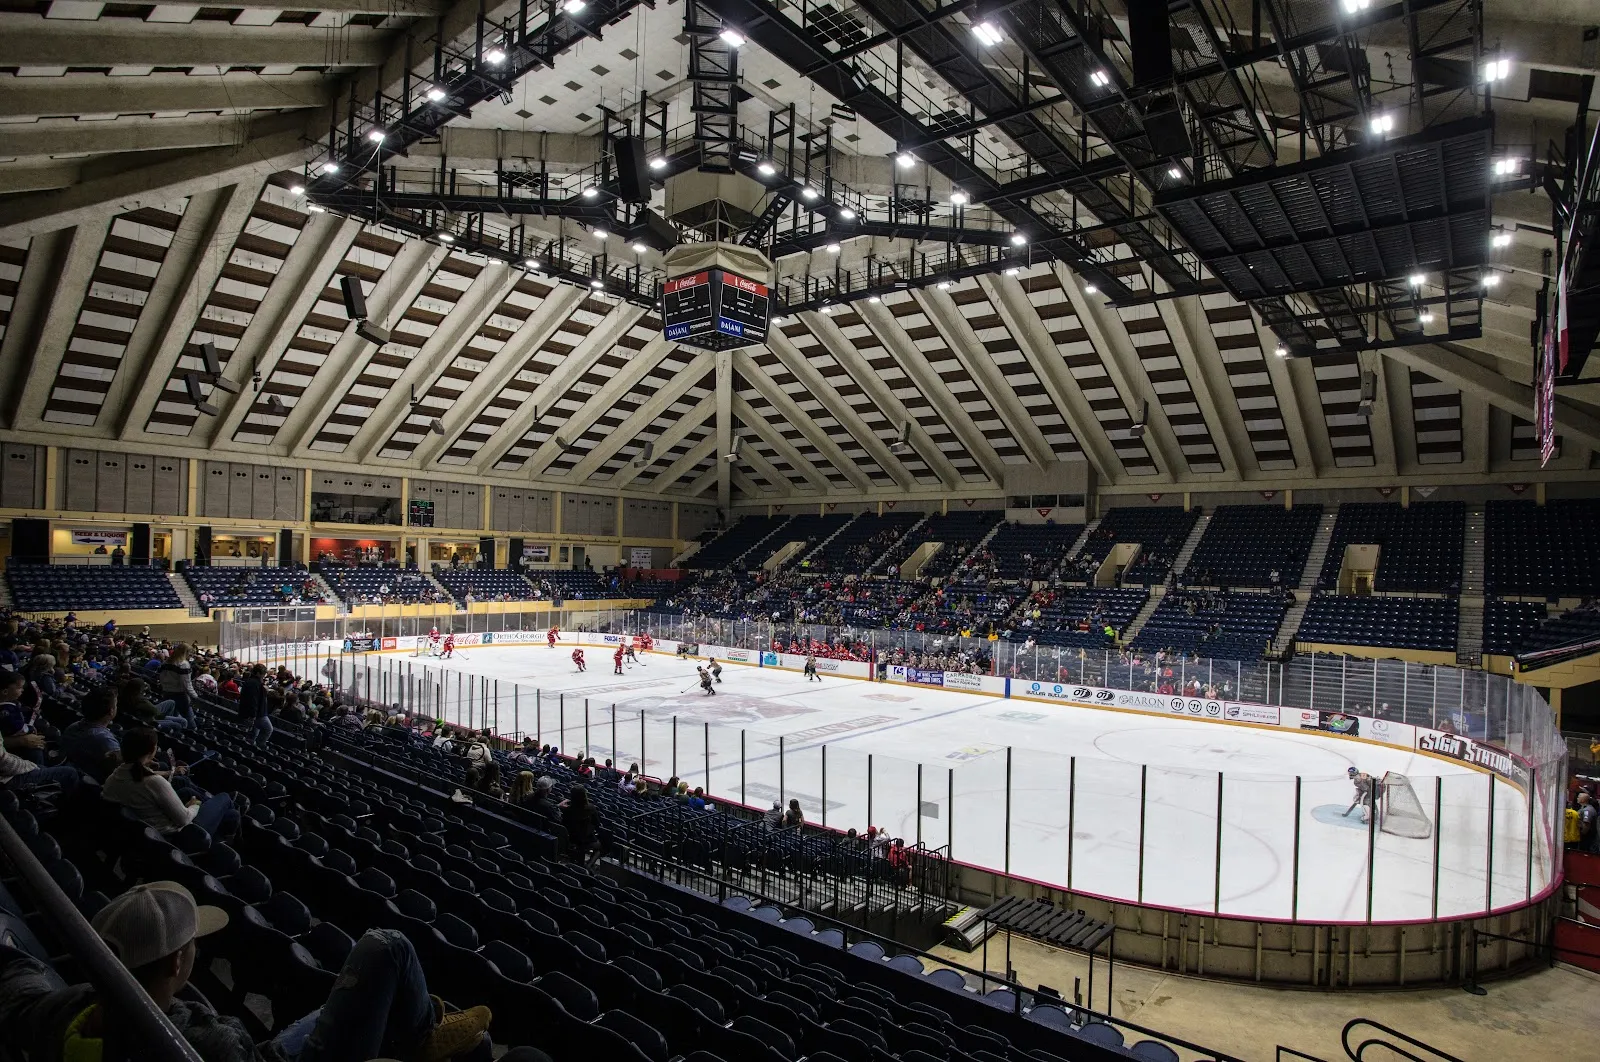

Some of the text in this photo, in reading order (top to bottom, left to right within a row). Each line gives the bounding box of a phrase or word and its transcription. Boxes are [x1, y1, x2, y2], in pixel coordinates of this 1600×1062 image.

[668, 326, 688, 337] DASANI
[720, 321, 742, 334] DASANI
[1128, 695, 1165, 707] BARON
[1421, 733, 1461, 755] SIGN
[1463, 739, 1513, 778] STATION
